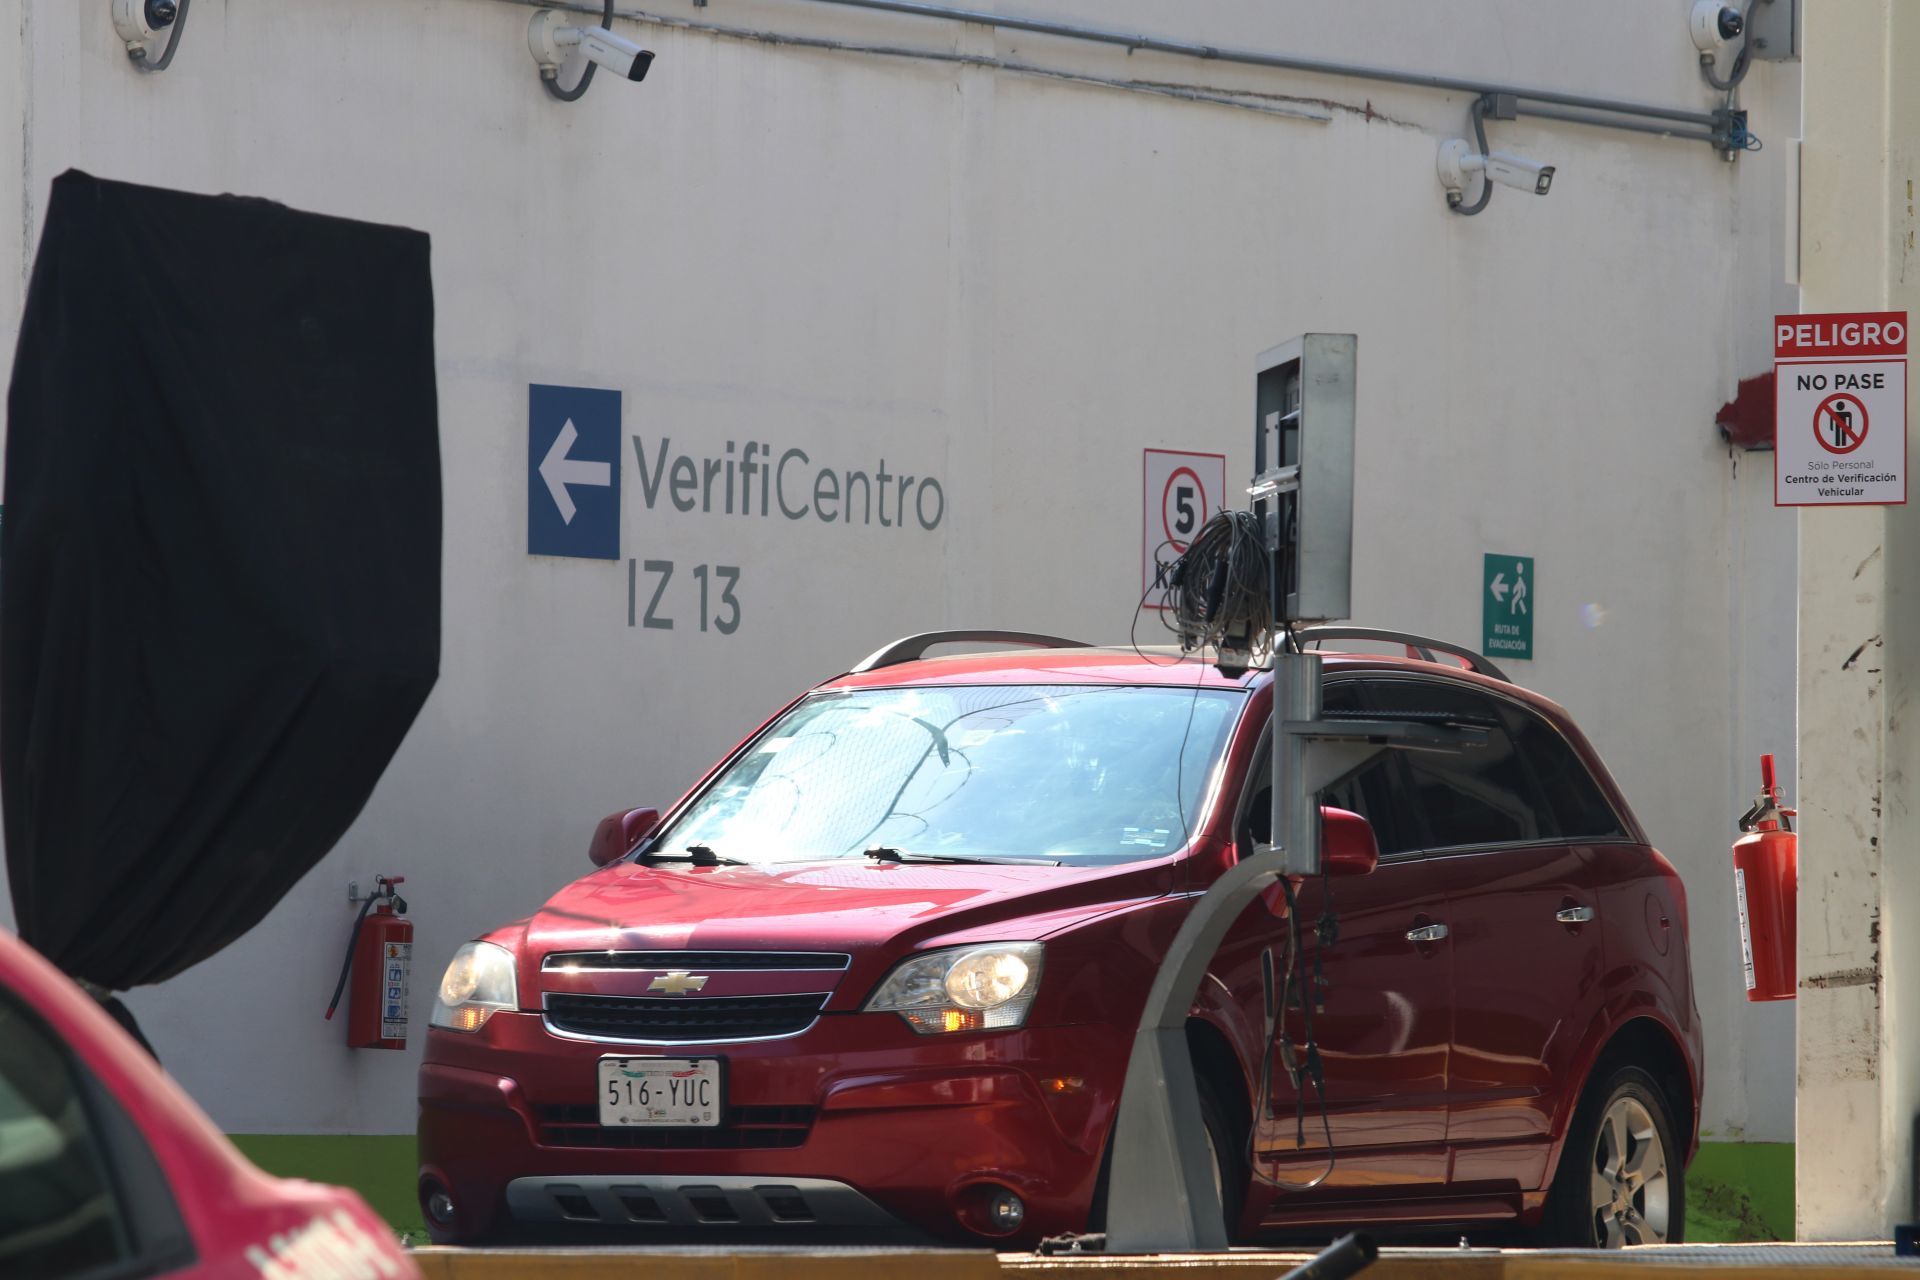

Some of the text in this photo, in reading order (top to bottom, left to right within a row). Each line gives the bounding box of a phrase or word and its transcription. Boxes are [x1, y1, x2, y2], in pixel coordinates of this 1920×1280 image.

[1777, 321, 1905, 348] PELIGRO
[1797, 373, 1885, 391] NO PASE
[1832, 460, 1874, 471] Personal
[631, 434, 945, 532] VerifiCentro
[1785, 472, 1897, 484] Centro de Verificación
[1818, 487, 1865, 497] Vehicular
[1176, 487, 1194, 534] 5
[628, 558, 741, 635] IZ 13
[1494, 623, 1520, 635] RUTA DE
[1488, 638, 1527, 651] EVACUACIÓN
[608, 1079, 711, 1107] 516-YUC
